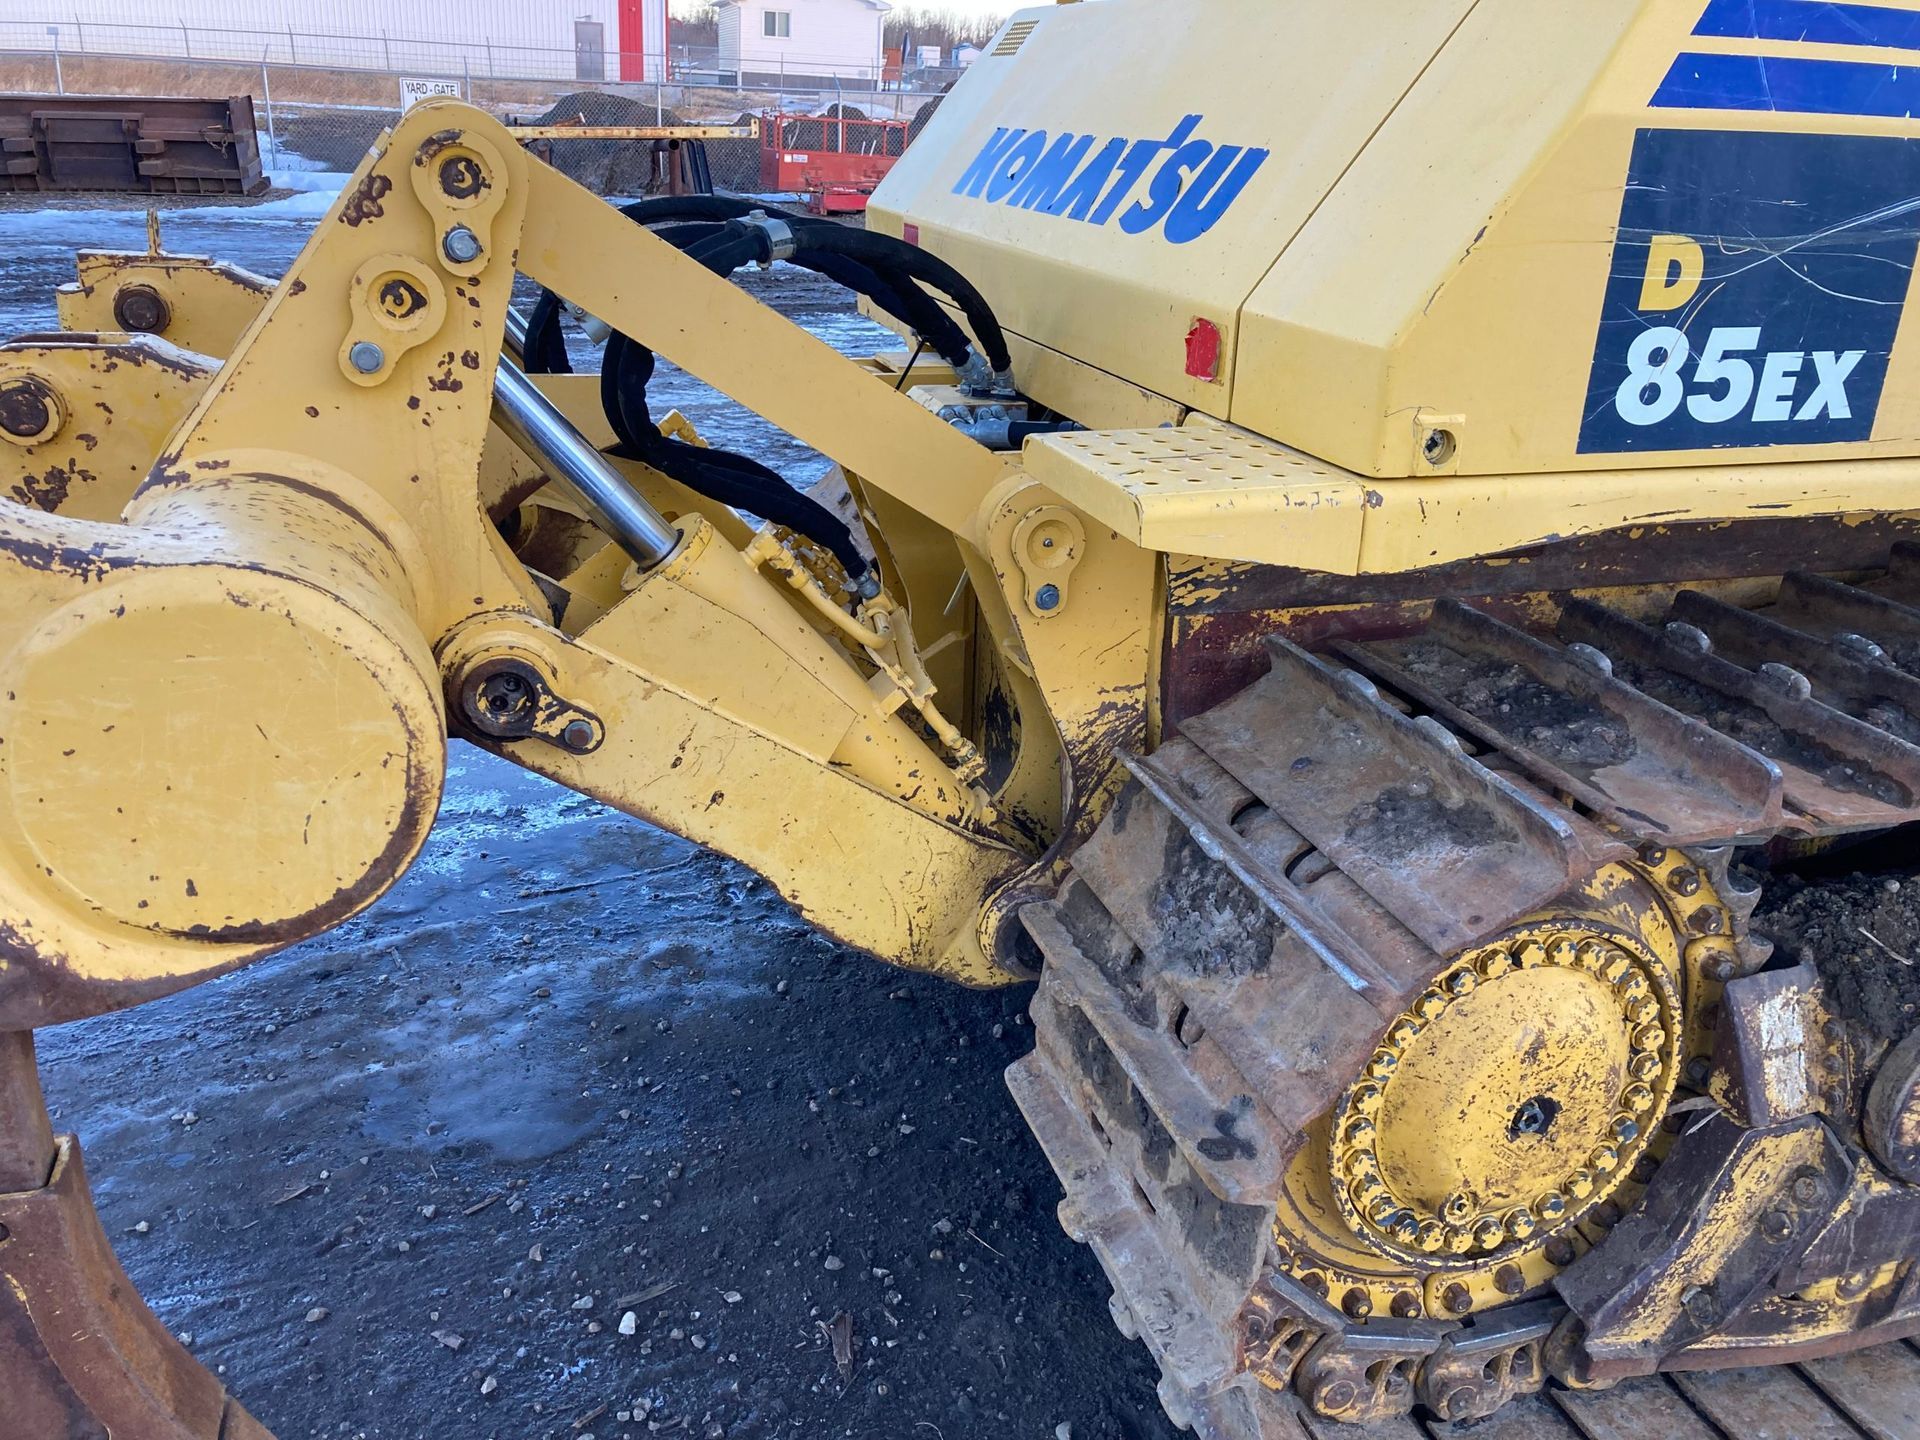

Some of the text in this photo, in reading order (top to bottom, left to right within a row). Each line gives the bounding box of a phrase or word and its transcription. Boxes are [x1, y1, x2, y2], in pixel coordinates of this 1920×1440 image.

[405, 82, 428, 95] YARD
[433, 84, 456, 97] GATE
[952, 114, 1270, 244] KOMATSU
[1637, 234, 1705, 311] D
